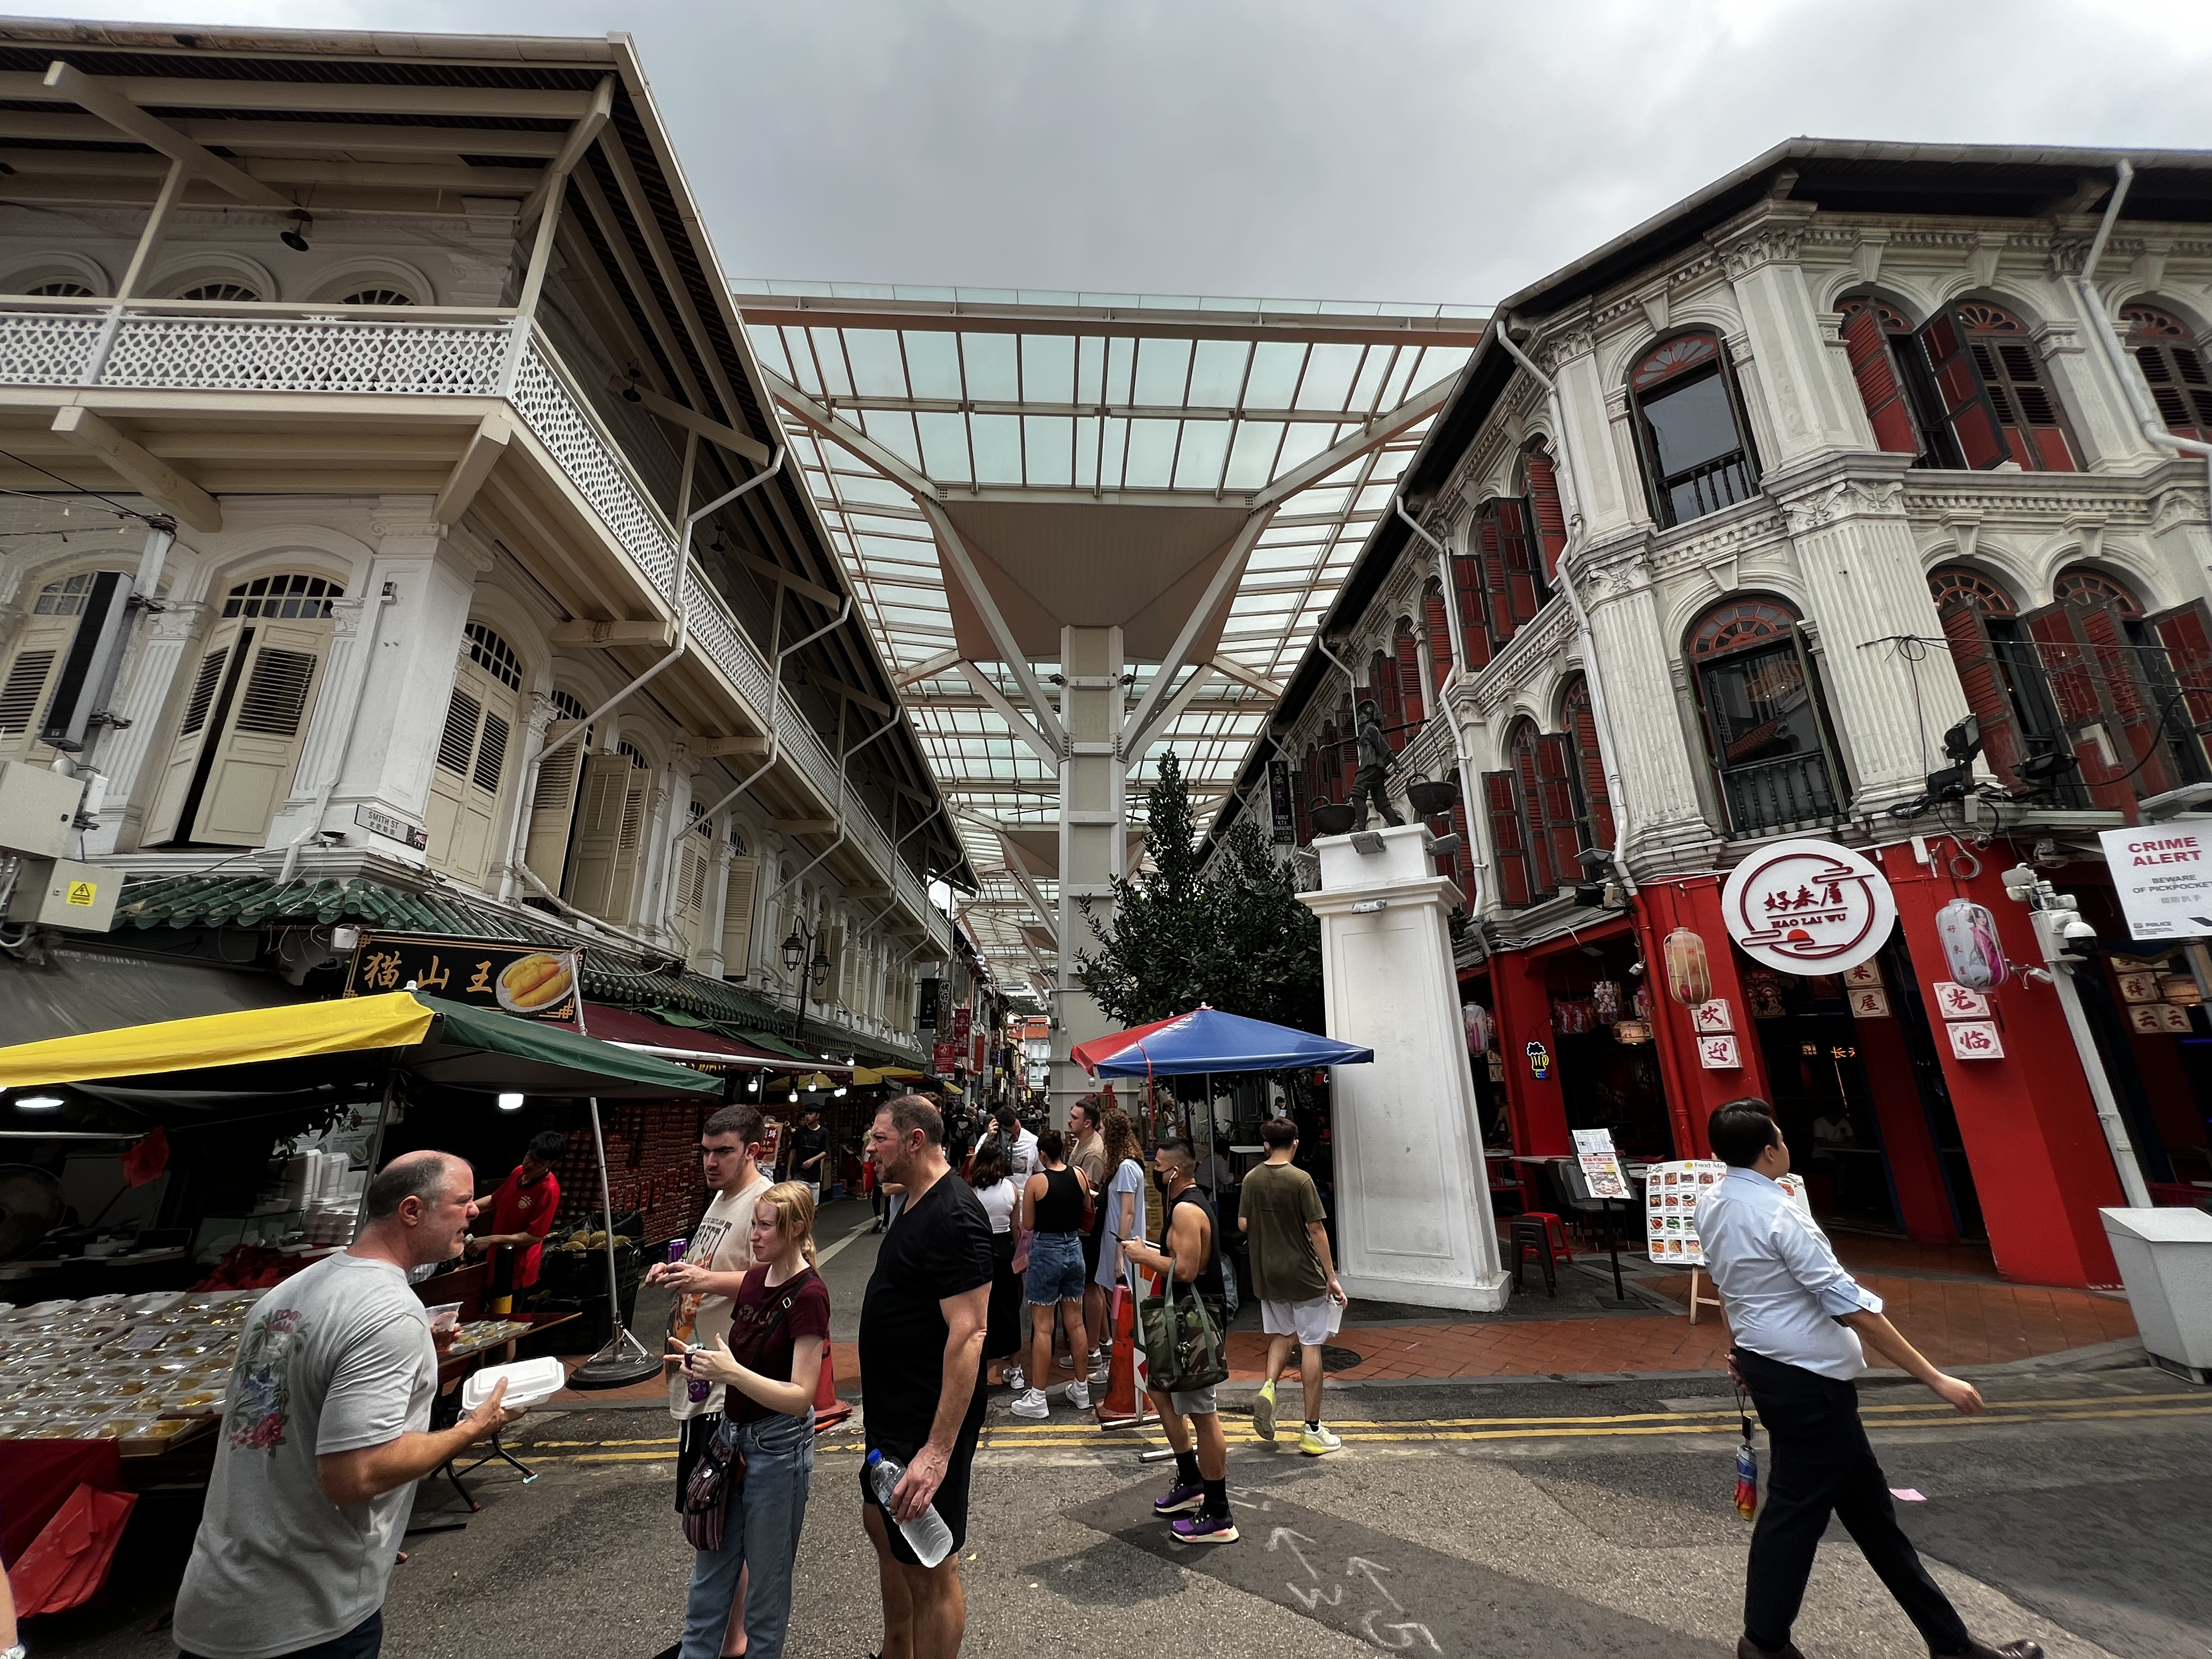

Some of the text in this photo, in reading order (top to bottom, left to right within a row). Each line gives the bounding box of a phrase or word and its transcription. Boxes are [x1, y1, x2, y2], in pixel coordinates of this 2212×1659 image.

[368, 811, 399, 829] SMITH ST
[2128, 837, 2199, 853] CRIME
[2133, 850, 2202, 866] ALERT
[2152, 874, 2197, 884] BEWARE
[1771, 914, 1846, 928] HAO LAI WU
[363, 951, 493, 993] 猫山王
[1947, 988, 1991, 1050] 光临
[1699, 1005, 1728, 1062] 欢迎
